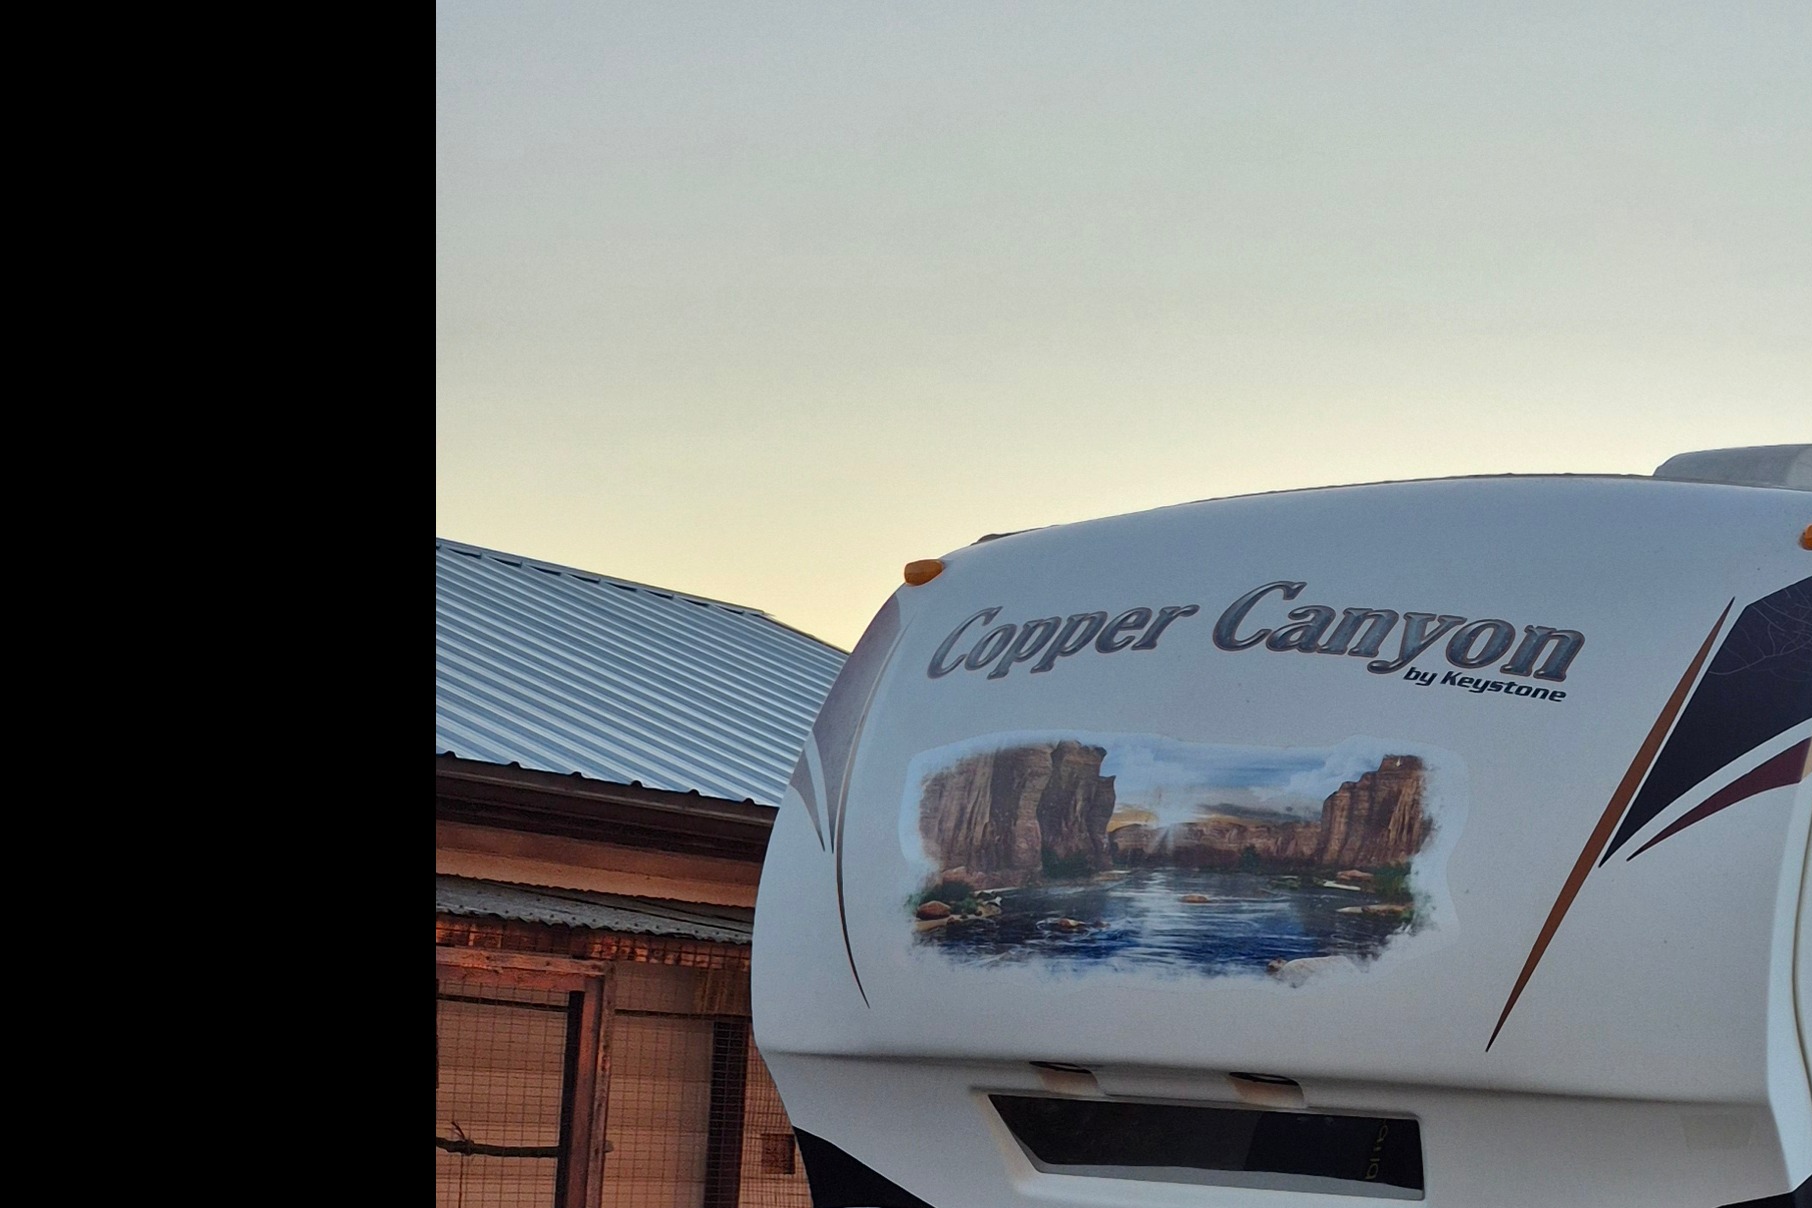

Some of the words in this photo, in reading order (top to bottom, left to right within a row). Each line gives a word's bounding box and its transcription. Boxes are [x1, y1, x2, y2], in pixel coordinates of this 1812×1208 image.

[928, 604, 1199, 680] Copper
[1211, 580, 1586, 682] Canyon
[1403, 667, 1438, 687] by
[1440, 671, 1567, 702] Keystone
